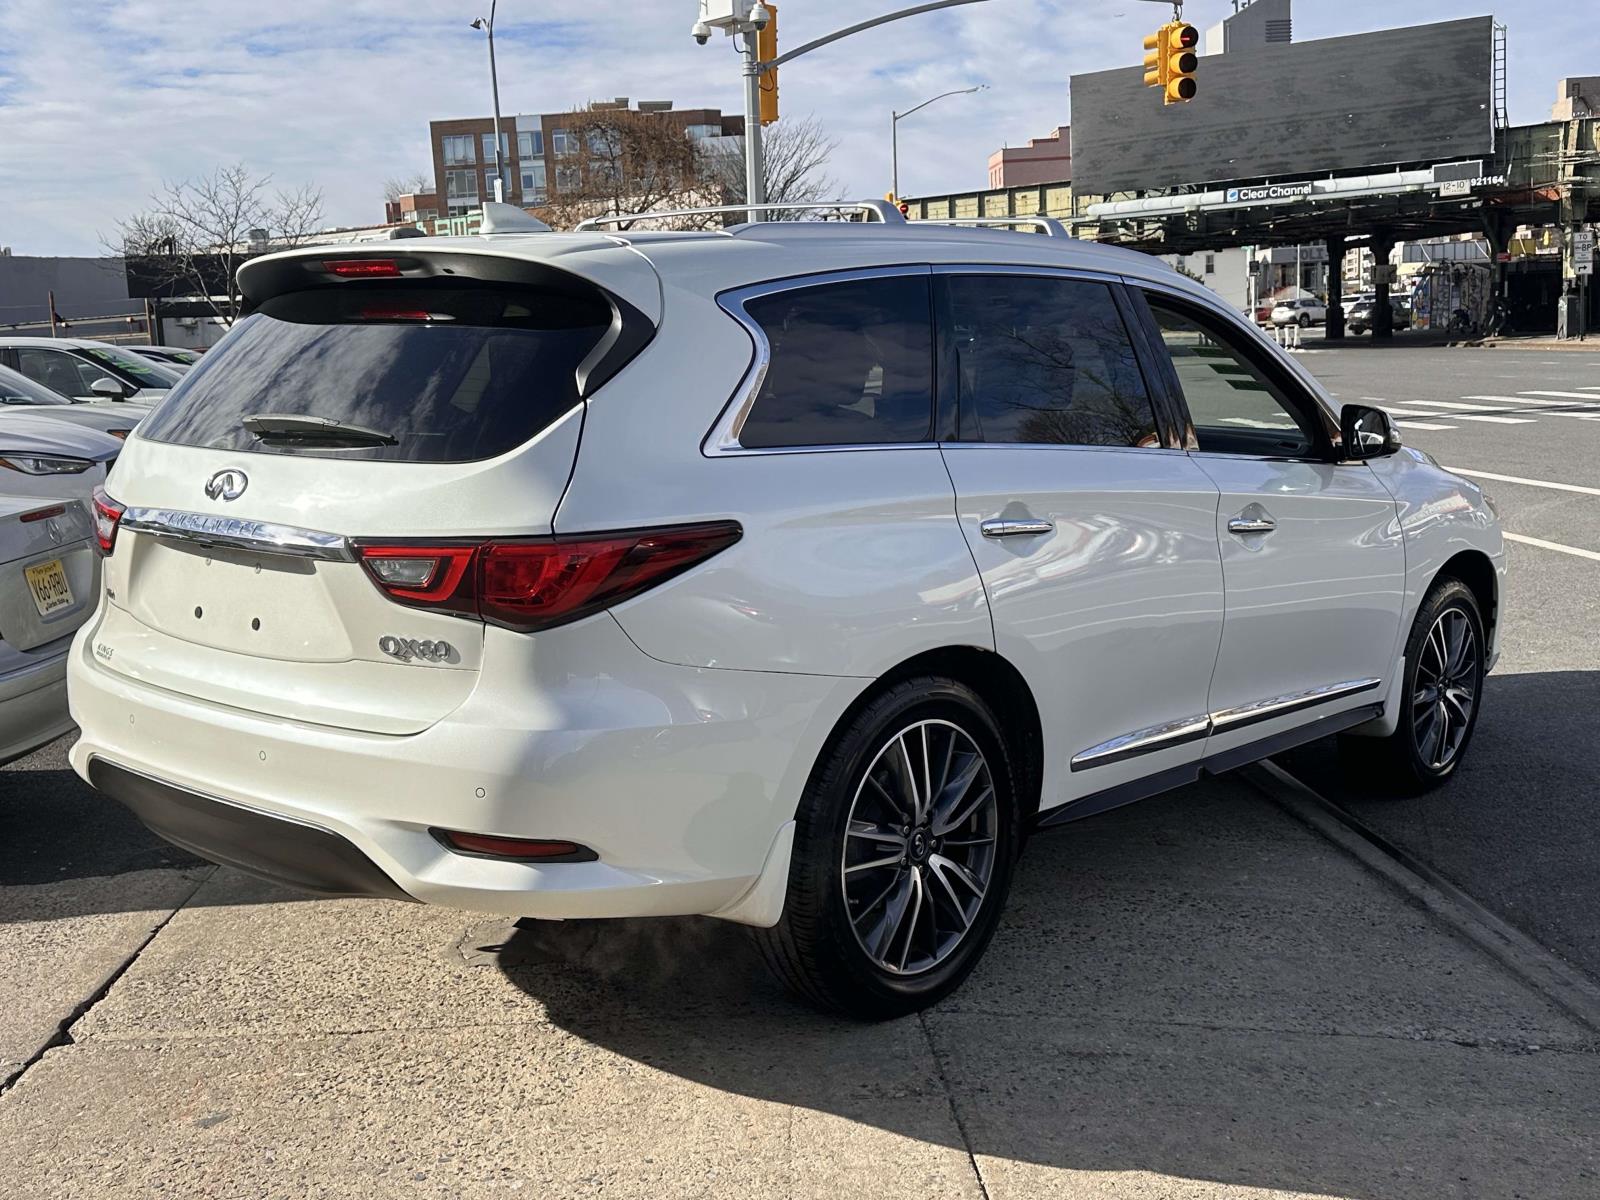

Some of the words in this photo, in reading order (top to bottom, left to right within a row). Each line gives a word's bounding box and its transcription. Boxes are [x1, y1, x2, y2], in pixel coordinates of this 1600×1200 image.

[1470, 175, 1504, 186] 921164
[1240, 189, 1268, 200] Clear
[1269, 183, 1312, 197] Channel
[97, 643, 114, 657] KINGS
[378, 635, 452, 663] QX60
